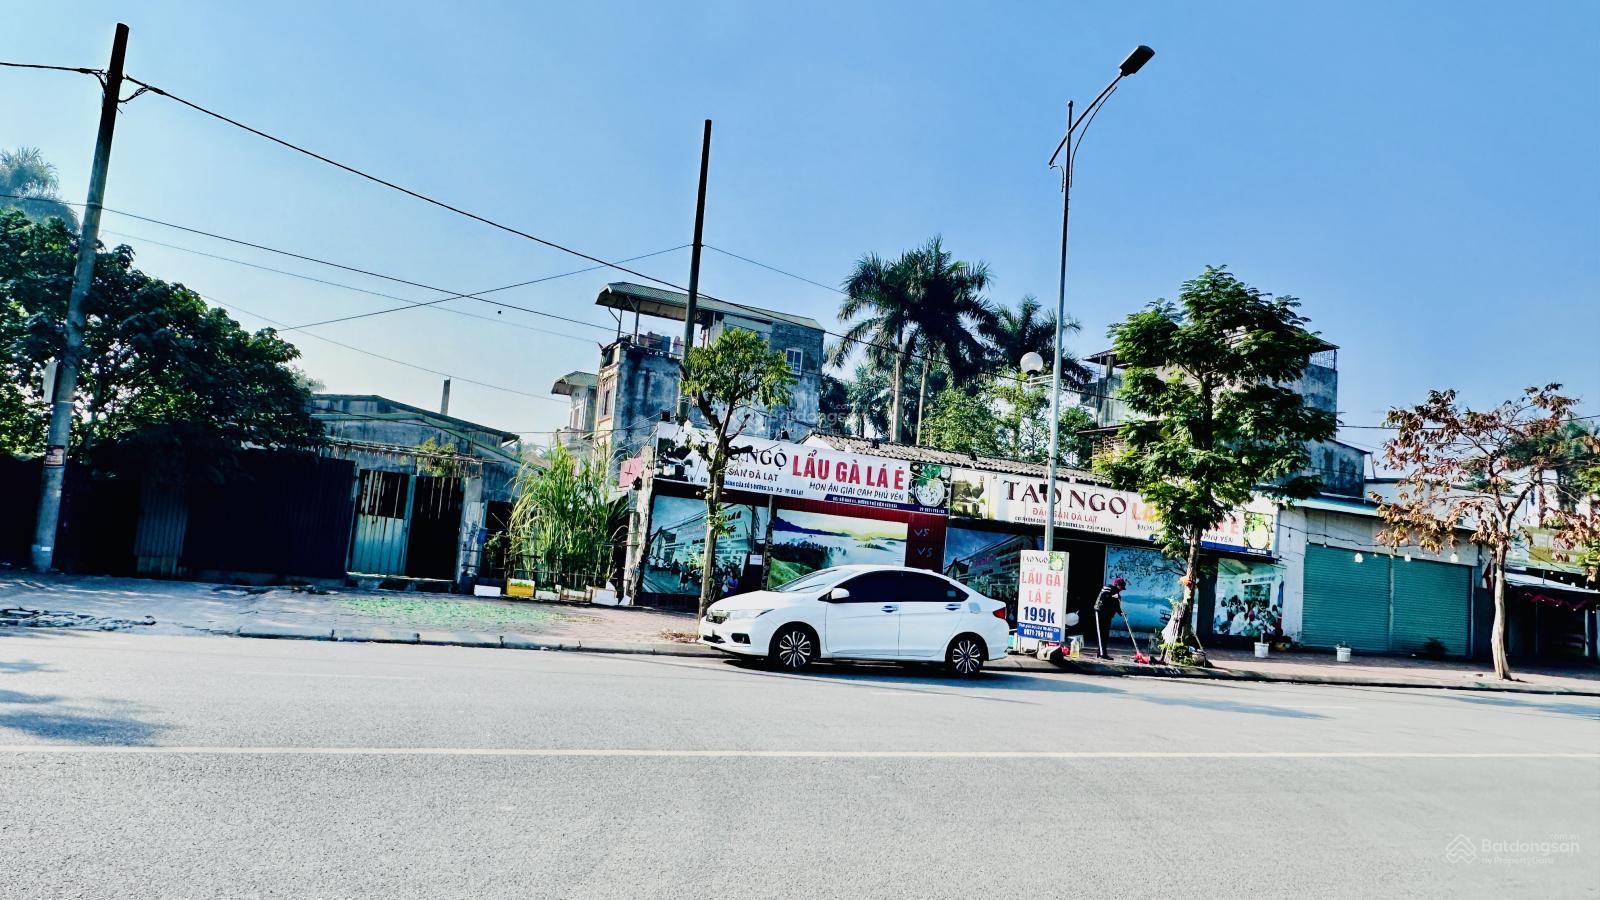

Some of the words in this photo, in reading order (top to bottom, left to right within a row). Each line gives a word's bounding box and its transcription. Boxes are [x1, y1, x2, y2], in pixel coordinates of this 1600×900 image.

[835, 459, 861, 485] GÀ
[866, 463, 888, 489] LÁ
[1045, 572, 1061, 587] GÀ
